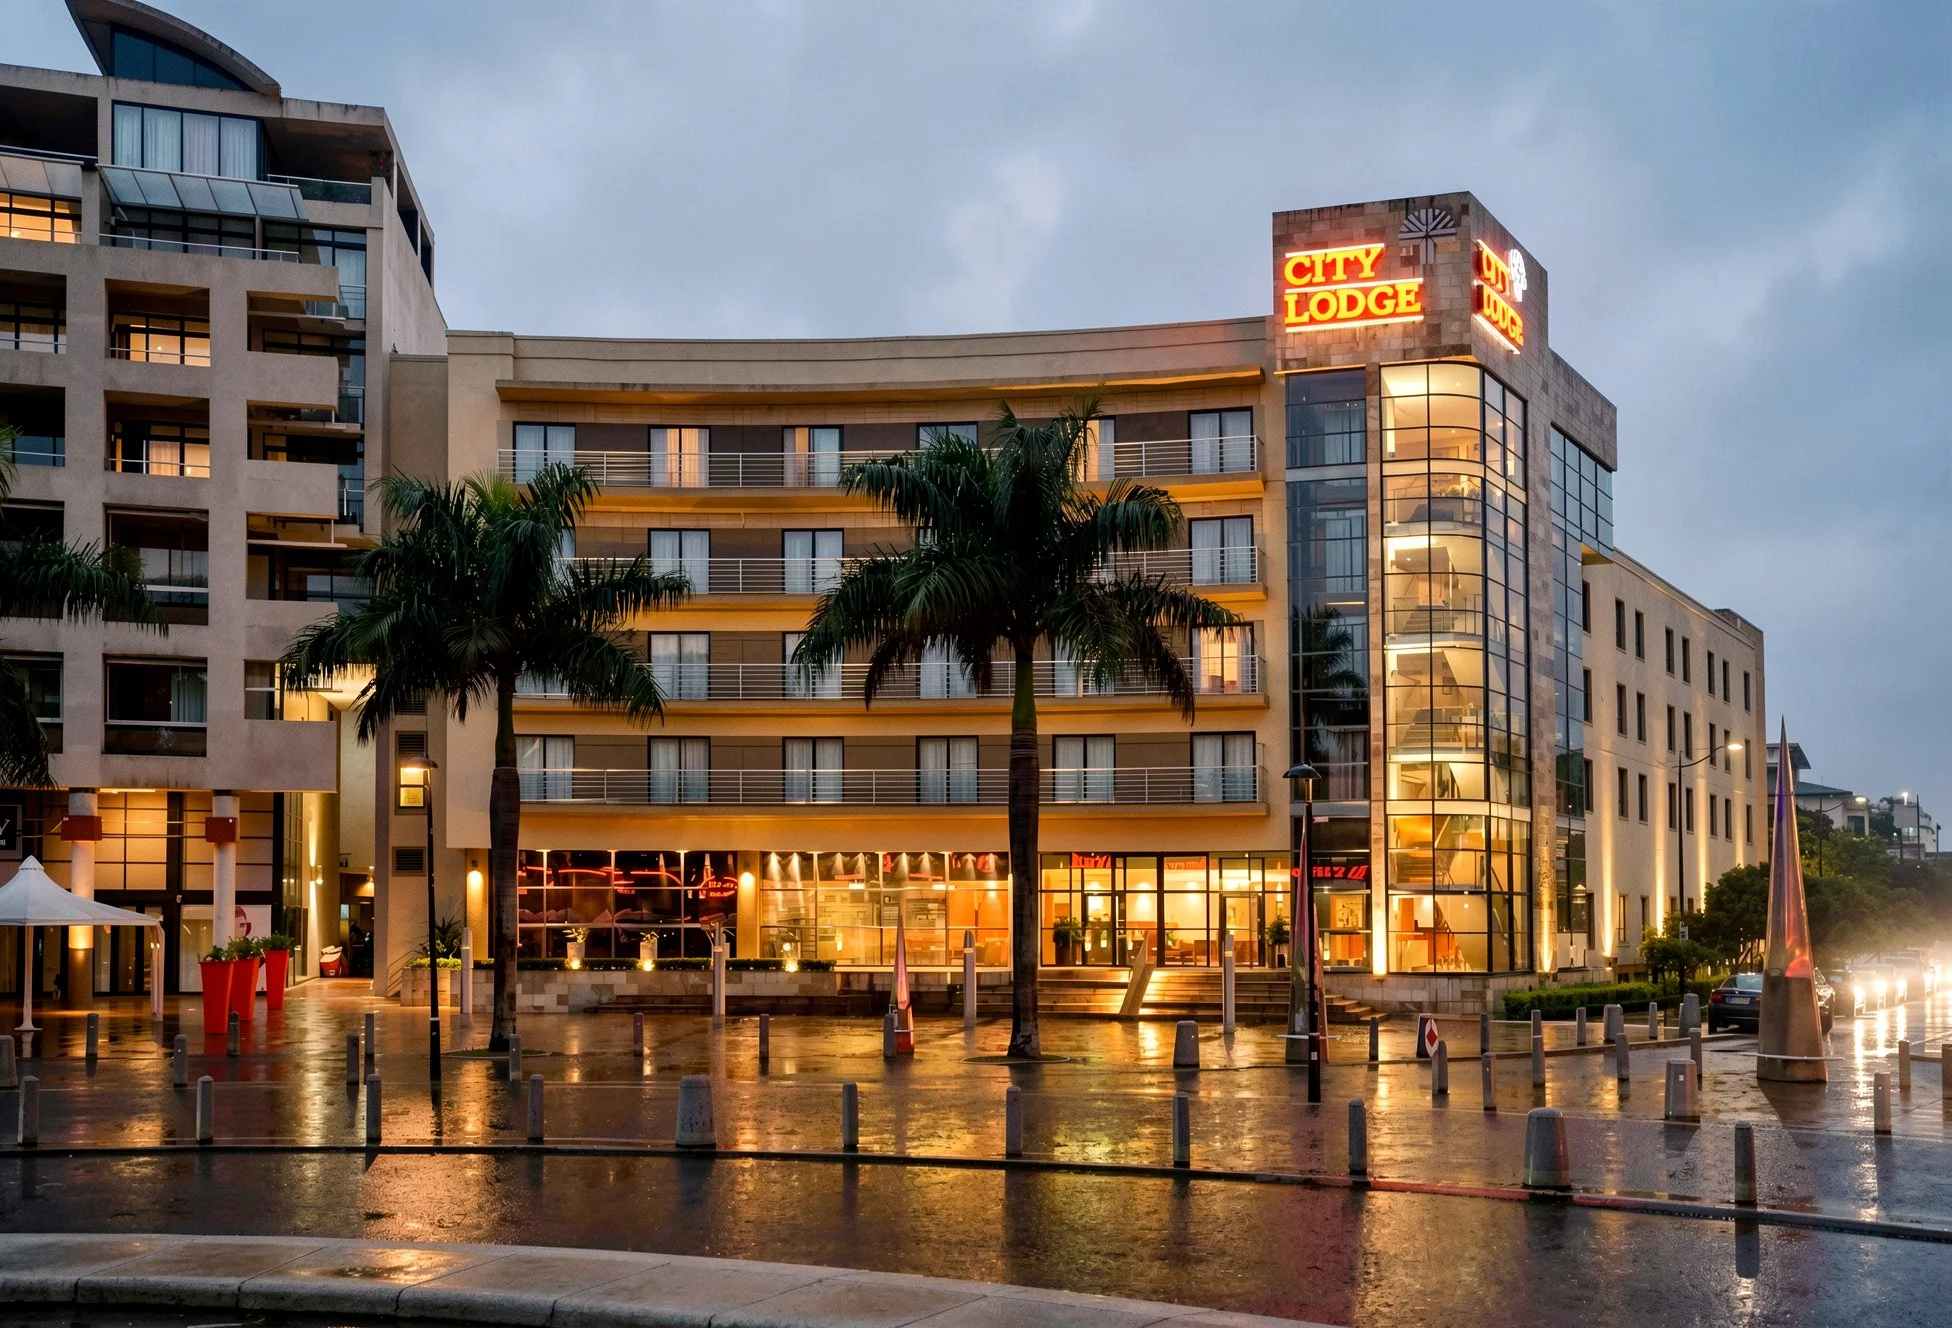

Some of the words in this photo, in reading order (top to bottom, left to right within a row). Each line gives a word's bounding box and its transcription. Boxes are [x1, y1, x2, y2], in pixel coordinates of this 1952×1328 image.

[1284, 248, 1382, 285] CITY
[1284, 283, 1421, 324] LODGE
[1483, 285, 1524, 346] LODGE
